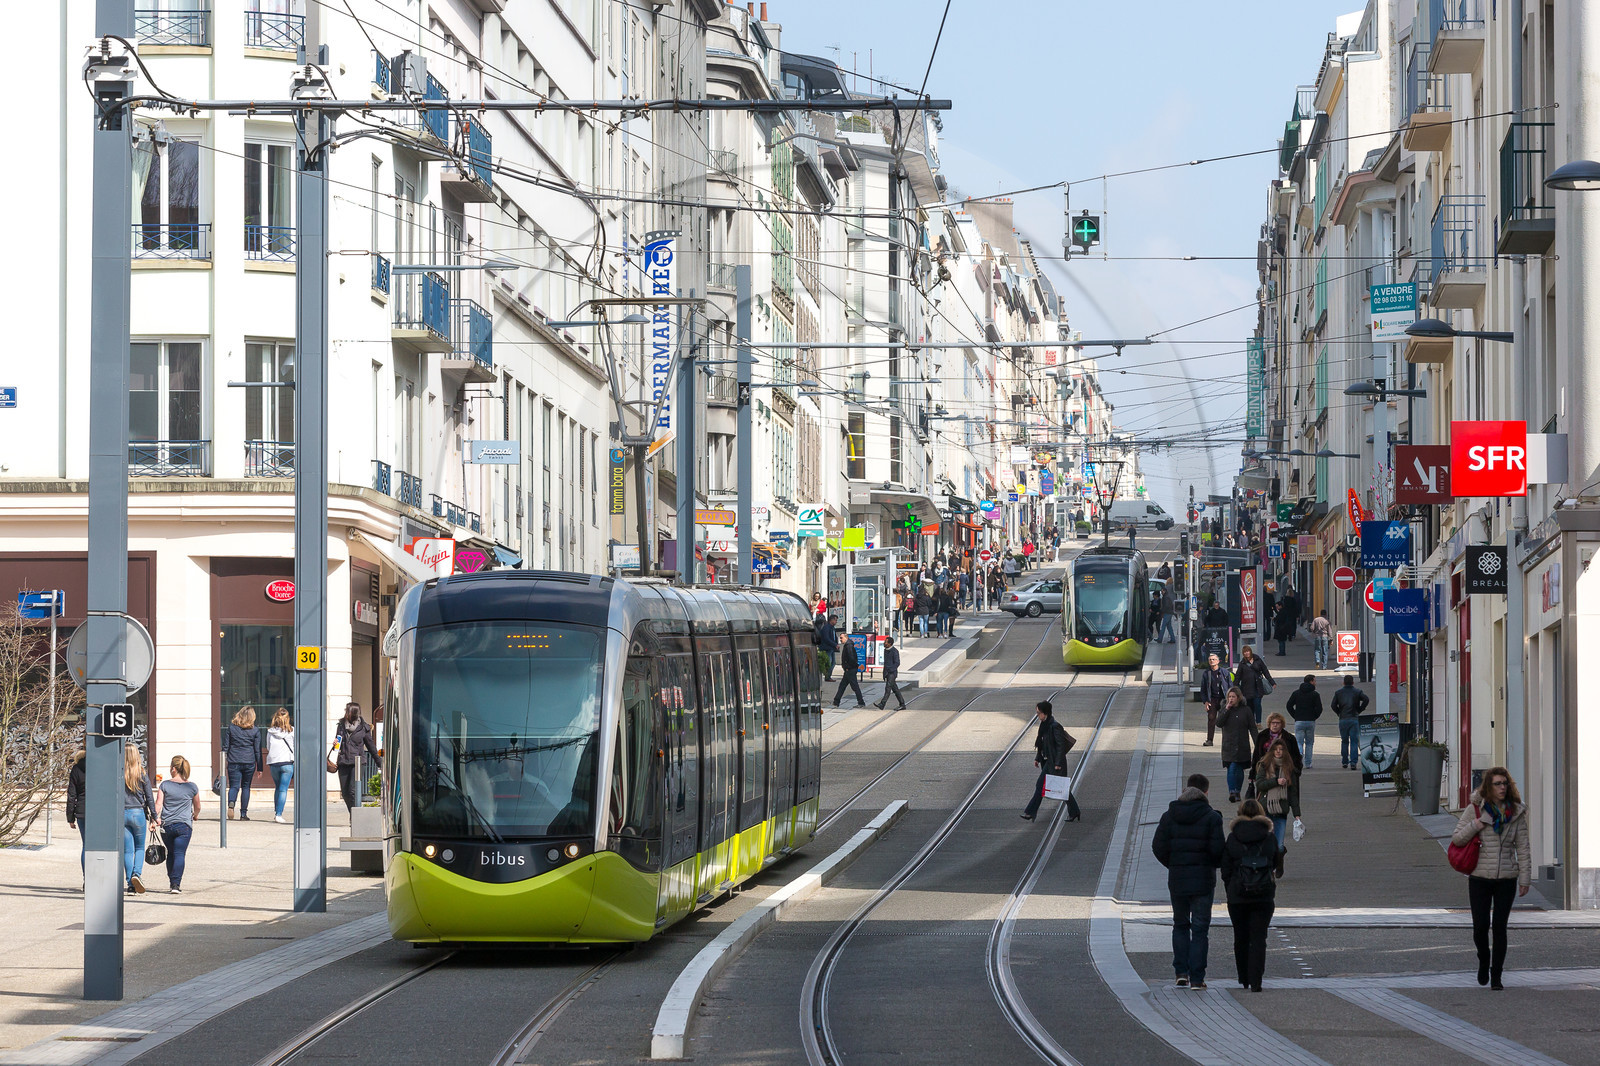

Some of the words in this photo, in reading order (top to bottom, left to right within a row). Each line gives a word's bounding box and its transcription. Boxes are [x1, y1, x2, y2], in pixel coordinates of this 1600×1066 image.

[1373, 288, 1379, 297] A
[1380, 285, 1414, 296] VENDRE
[1248, 349, 1260, 428] PRINTEMPS
[1468, 446, 1525, 471] SFR
[611, 467, 624, 488] bara
[611, 488, 624, 514] tamm
[696, 512, 729, 522] ICOLAS
[1350, 498, 1361, 528] TABAC
[416, 543, 450, 572] Virgin
[272, 584, 294, 592] Brioche
[1472, 579, 1507, 587] BRÉAL
[1389, 605, 1419, 614] Nocibé
[300, 652, 316, 664] 30
[109, 712, 127, 727] IS
[480, 850, 525, 867] bibus
